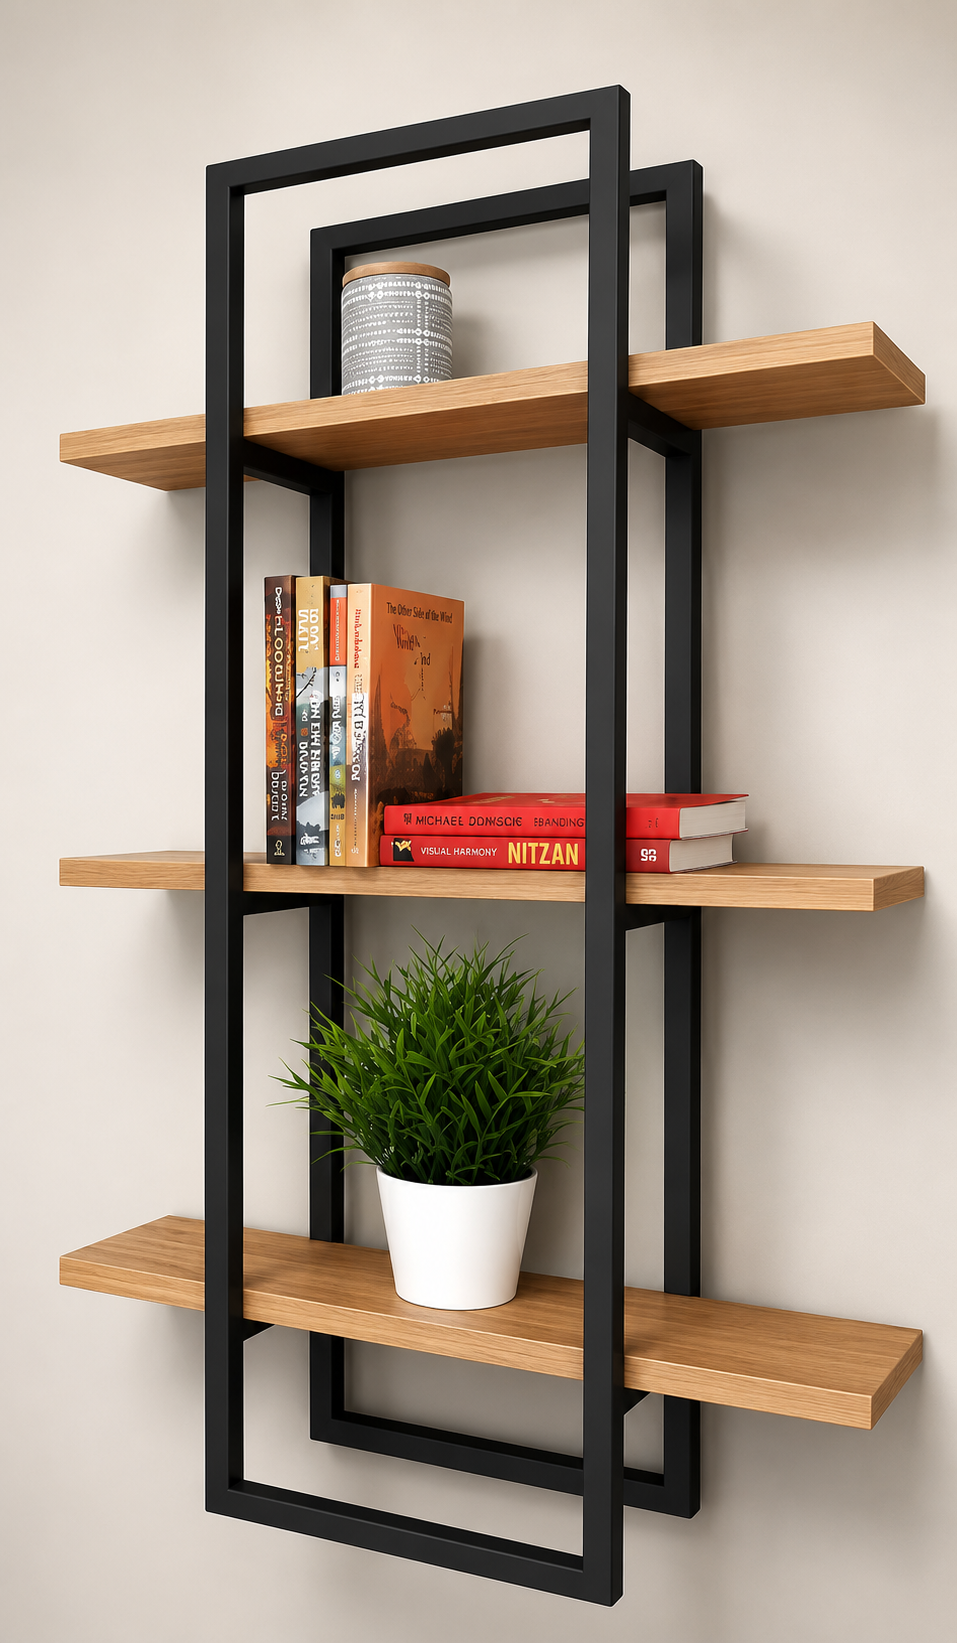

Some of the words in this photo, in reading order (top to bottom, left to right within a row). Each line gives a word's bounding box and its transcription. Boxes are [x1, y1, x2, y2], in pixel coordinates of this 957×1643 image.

[386, 602, 396, 614] The
[420, 847, 452, 856] VISUAL
[453, 847, 498, 857] HARMONY
[508, 842, 579, 866] NITZAN
